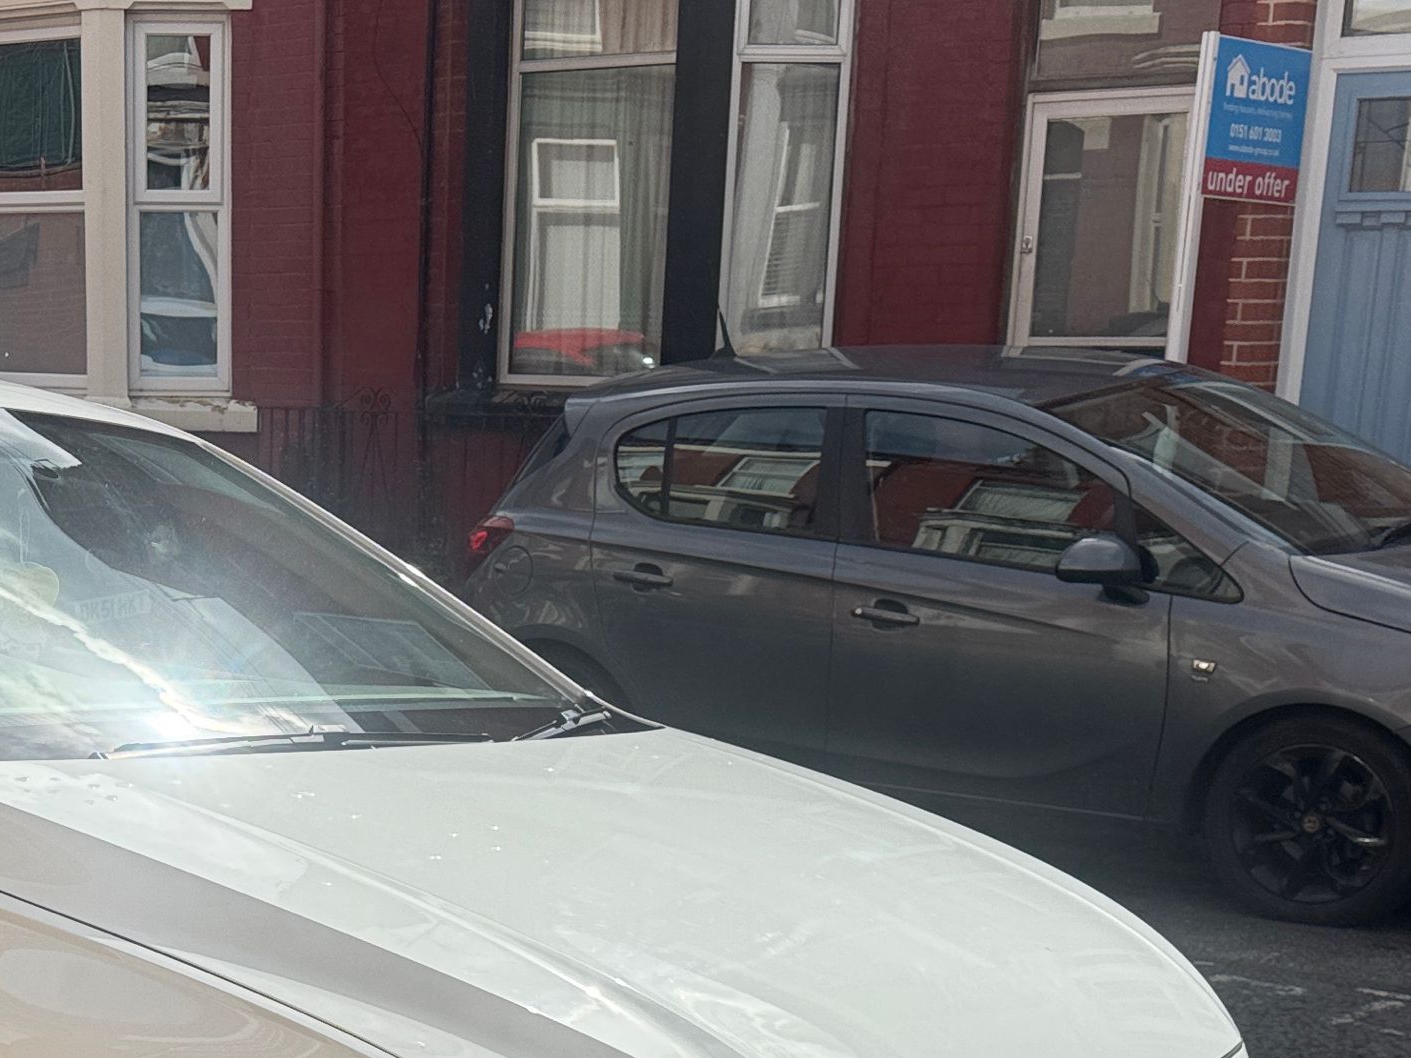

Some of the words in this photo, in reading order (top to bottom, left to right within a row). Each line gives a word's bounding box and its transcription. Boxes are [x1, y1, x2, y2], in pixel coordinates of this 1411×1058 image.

[1248, 67, 1296, 105] abode
[1230, 123, 1248, 139] 0151
[1207, 167, 1253, 196] under
[1254, 171, 1291, 199] offer
